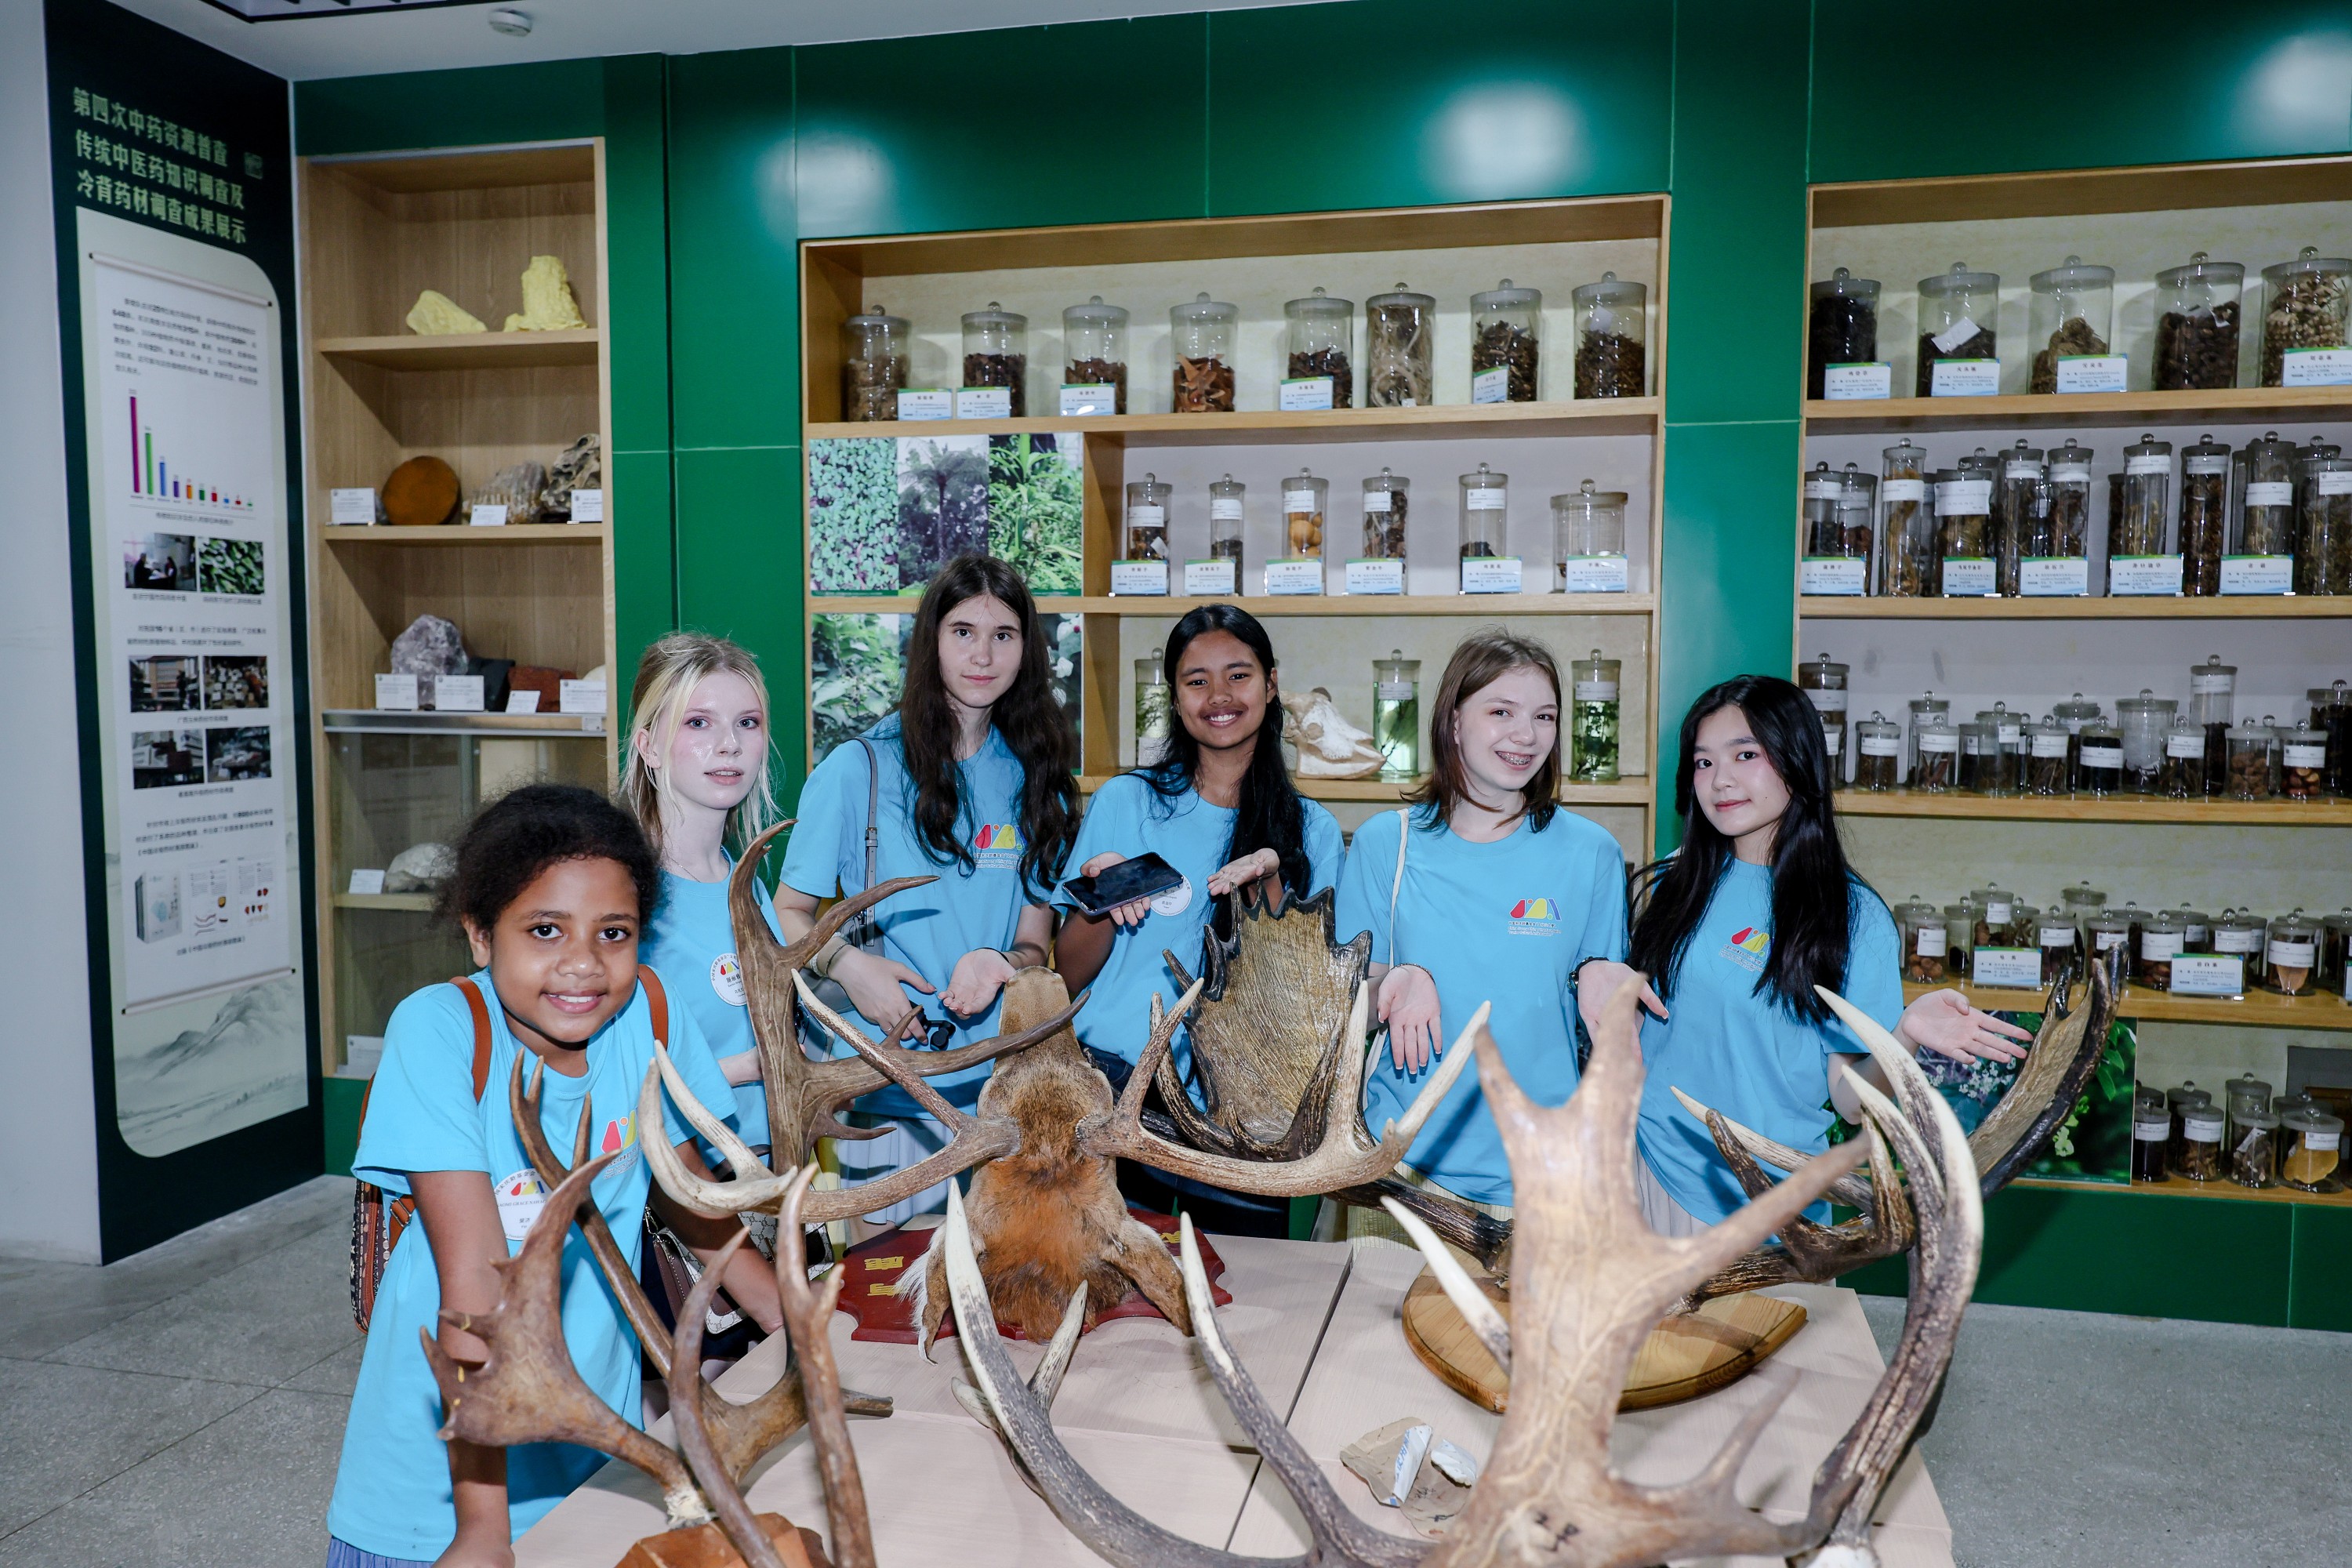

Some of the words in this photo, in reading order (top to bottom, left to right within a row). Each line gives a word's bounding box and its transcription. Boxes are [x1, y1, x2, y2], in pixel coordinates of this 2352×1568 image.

[73, 86, 227, 167] 第四次中药资源普查
[75, 129, 245, 210] 传统中医药知识调查及
